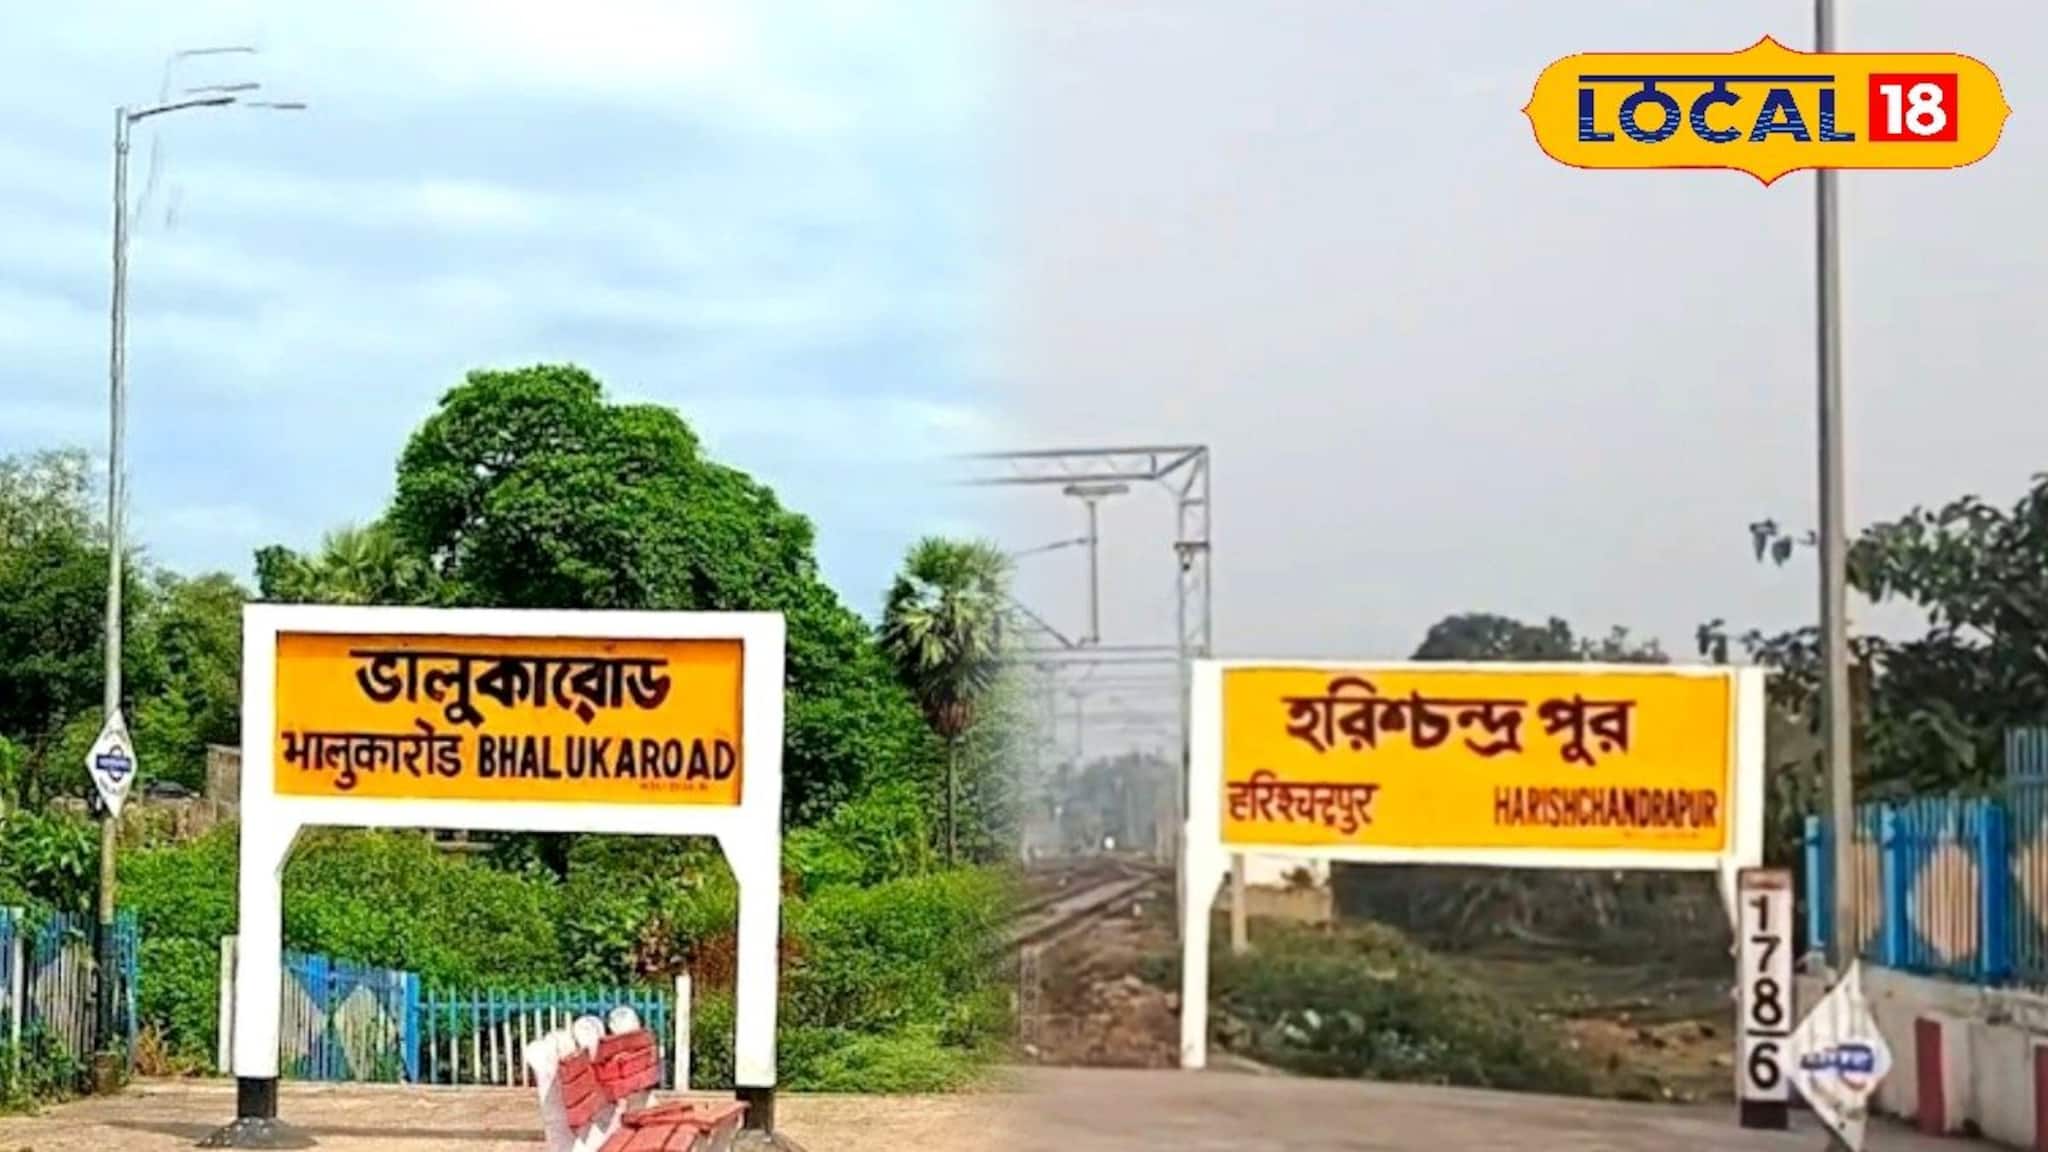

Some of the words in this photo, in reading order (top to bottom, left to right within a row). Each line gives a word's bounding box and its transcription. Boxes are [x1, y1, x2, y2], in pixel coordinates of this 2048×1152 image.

[350, 650, 671, 728] ভালুকারোড
[281, 717, 462, 791] भालुकारोड
[477, 734, 736, 781] BHALUKAROAD
[1494, 786, 1718, 829] HARISHCHANDRAPUR
